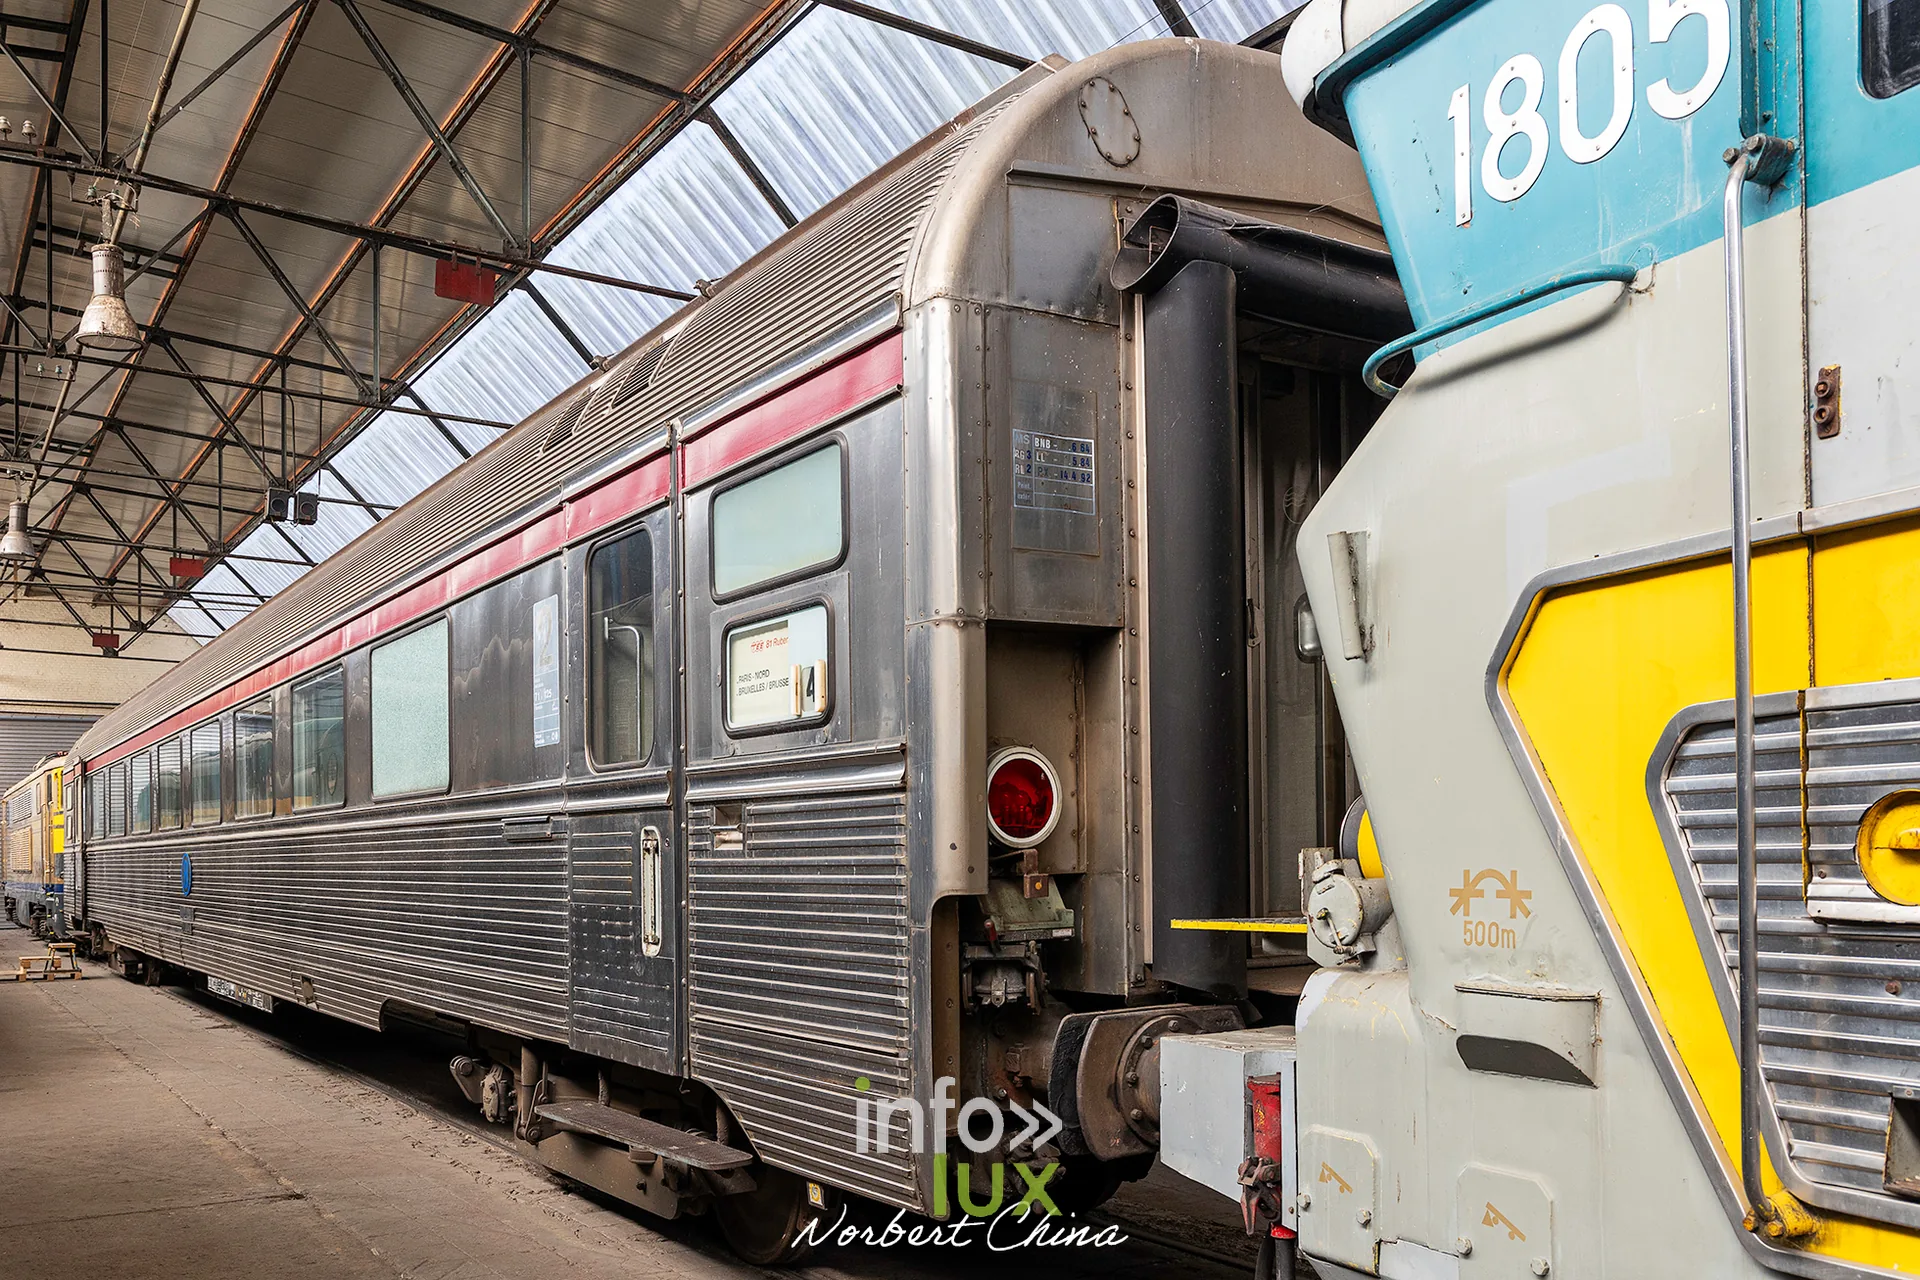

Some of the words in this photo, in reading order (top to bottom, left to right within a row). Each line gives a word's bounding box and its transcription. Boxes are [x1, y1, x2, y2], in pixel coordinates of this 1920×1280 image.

[1447, 0, 1731, 227] 1805
[1034, 437, 1051, 449] BNB
[1026, 450, 1032, 460] 3
[1026, 464, 1032, 473] 2
[806, 666, 815, 702] 4
[1463, 920, 1517, 950] 500m
